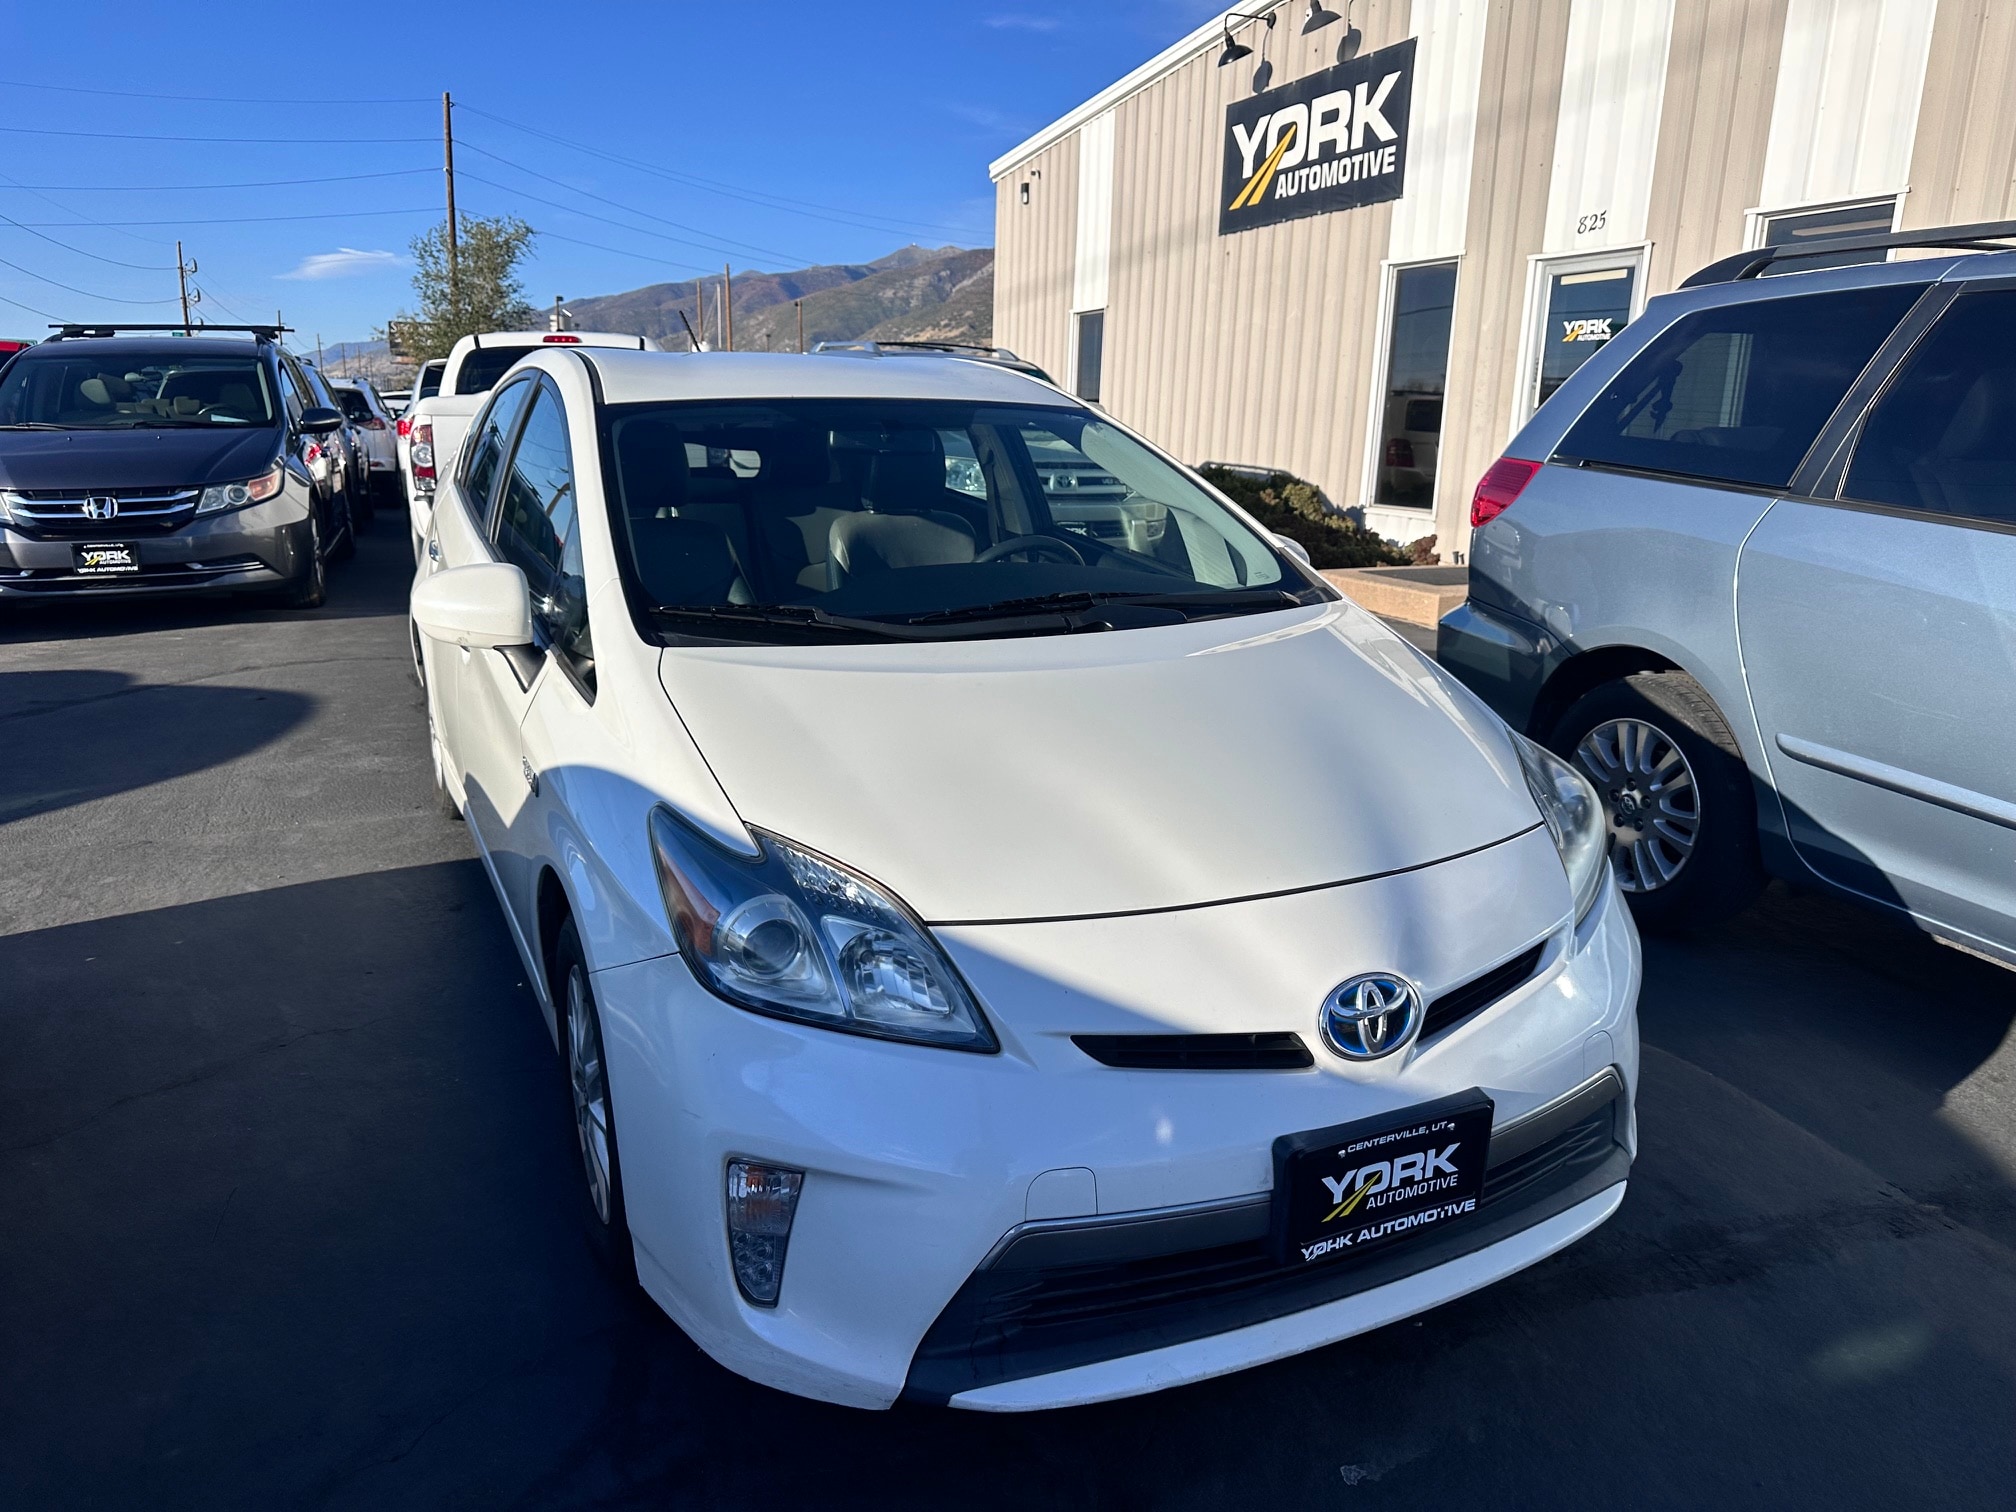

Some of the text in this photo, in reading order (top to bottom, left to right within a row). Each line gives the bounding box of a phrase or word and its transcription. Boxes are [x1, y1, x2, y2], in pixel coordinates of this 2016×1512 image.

[1231, 70, 1402, 179] YORK
[1274, 145, 1397, 200] AUTOMOTIVE
[1577, 209, 1608, 235] 825
[1563, 317, 1612, 335] YORK
[81, 550, 131, 561] YORK
[1347, 1121, 1449, 1153] CENTERVILLE, UT
[1321, 1142, 1462, 1205] YORK
[1365, 1173, 1459, 1211] AUTOMOTIVE
[1356, 1198, 1476, 1244] AUTOMOTIVE
